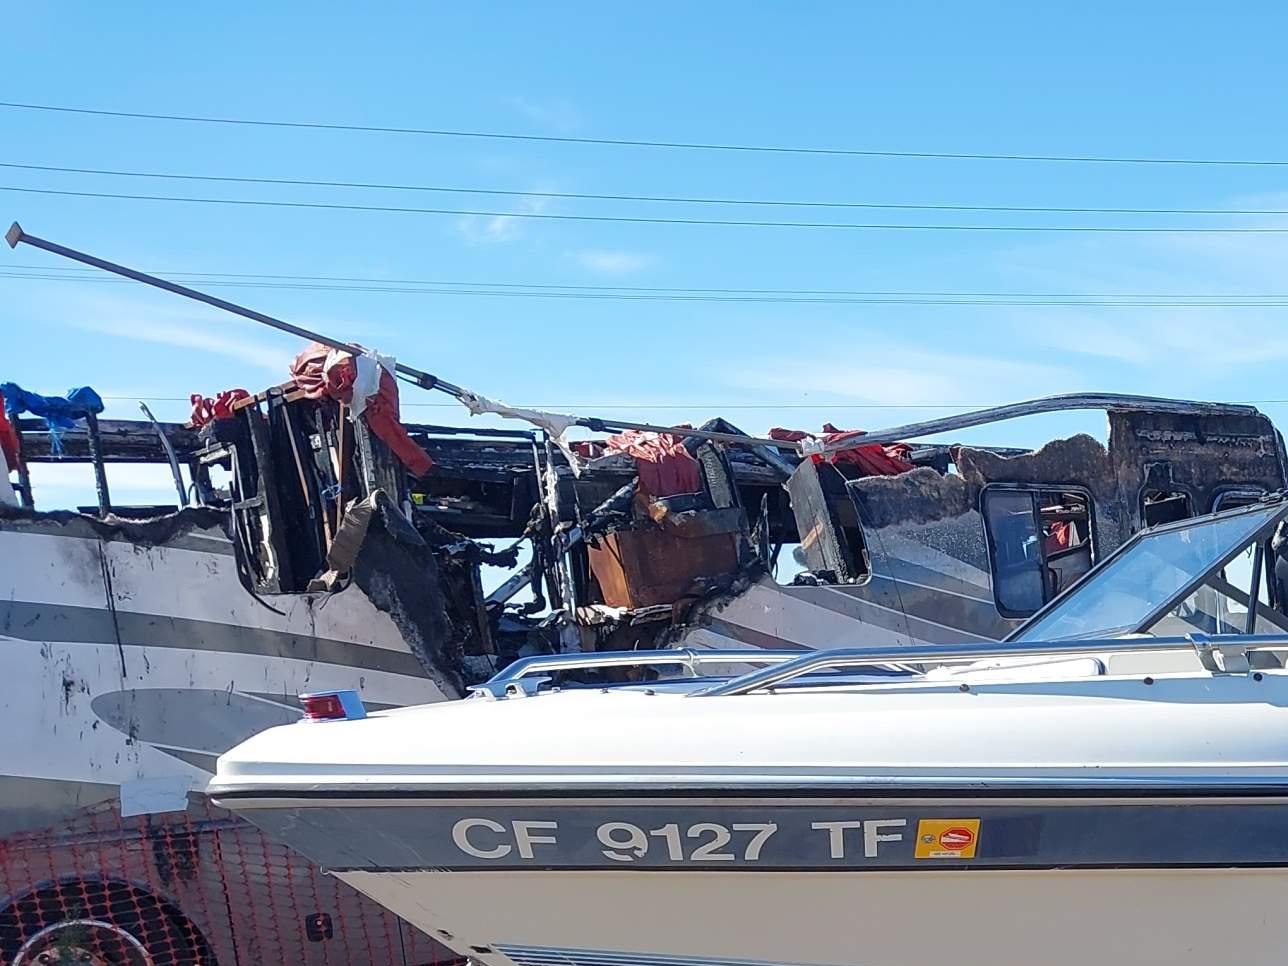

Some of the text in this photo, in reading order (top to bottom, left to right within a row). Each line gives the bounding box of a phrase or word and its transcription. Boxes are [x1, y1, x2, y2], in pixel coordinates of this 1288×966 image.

[451, 818, 907, 861] CF 9127 TF
